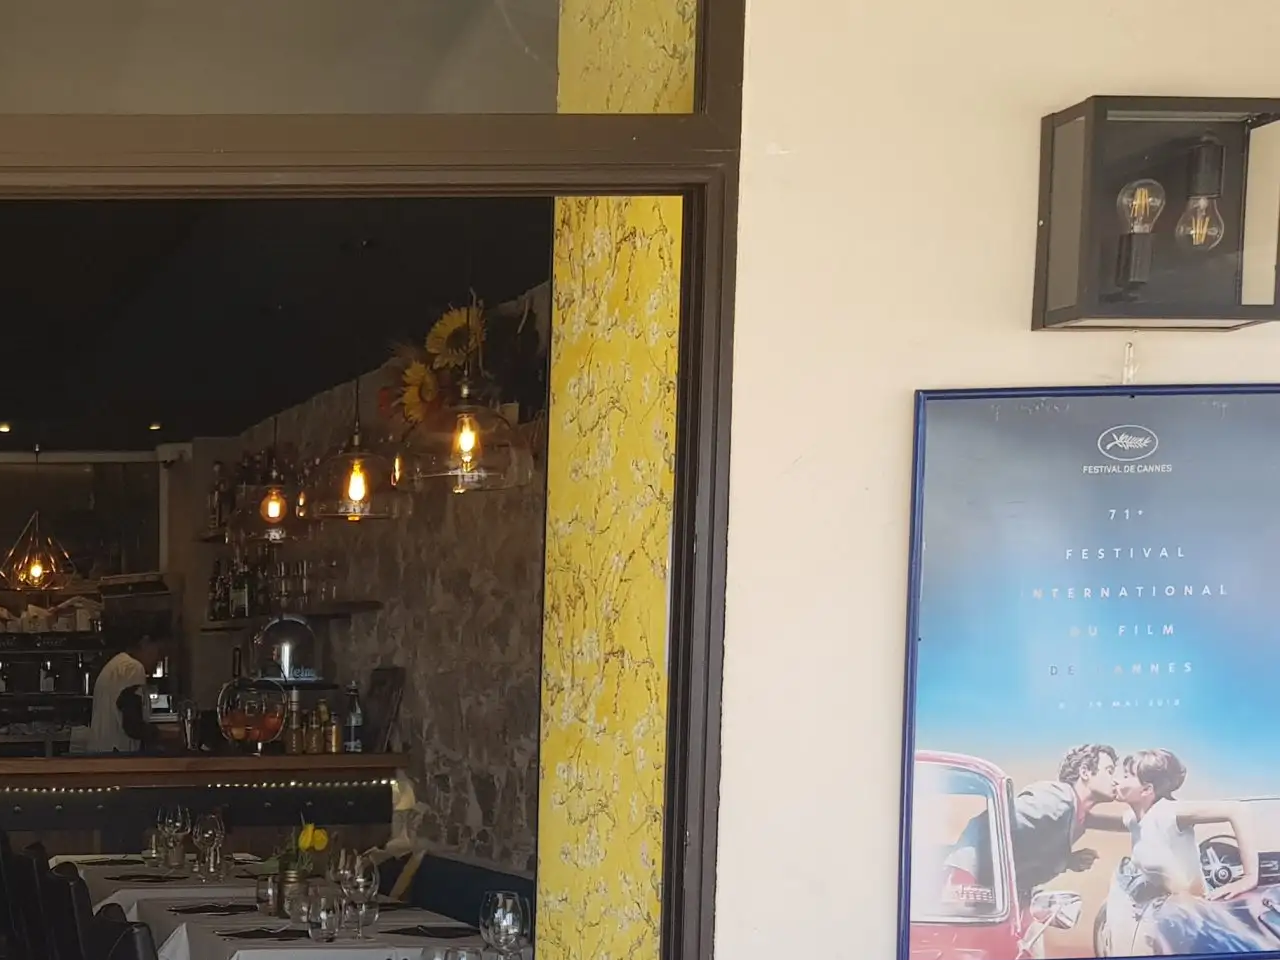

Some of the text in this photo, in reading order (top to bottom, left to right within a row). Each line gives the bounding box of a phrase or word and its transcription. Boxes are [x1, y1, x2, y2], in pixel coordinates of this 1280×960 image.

[1082, 464, 1173, 474] FESTIVAL DE CANNES
[1065, 546, 1186, 560] FESTIVAL
[1020, 584, 1229, 600] INTERNATIONAL
[1118, 623, 1175, 636] FILM
[1049, 662, 1193, 676] DE ANNES
